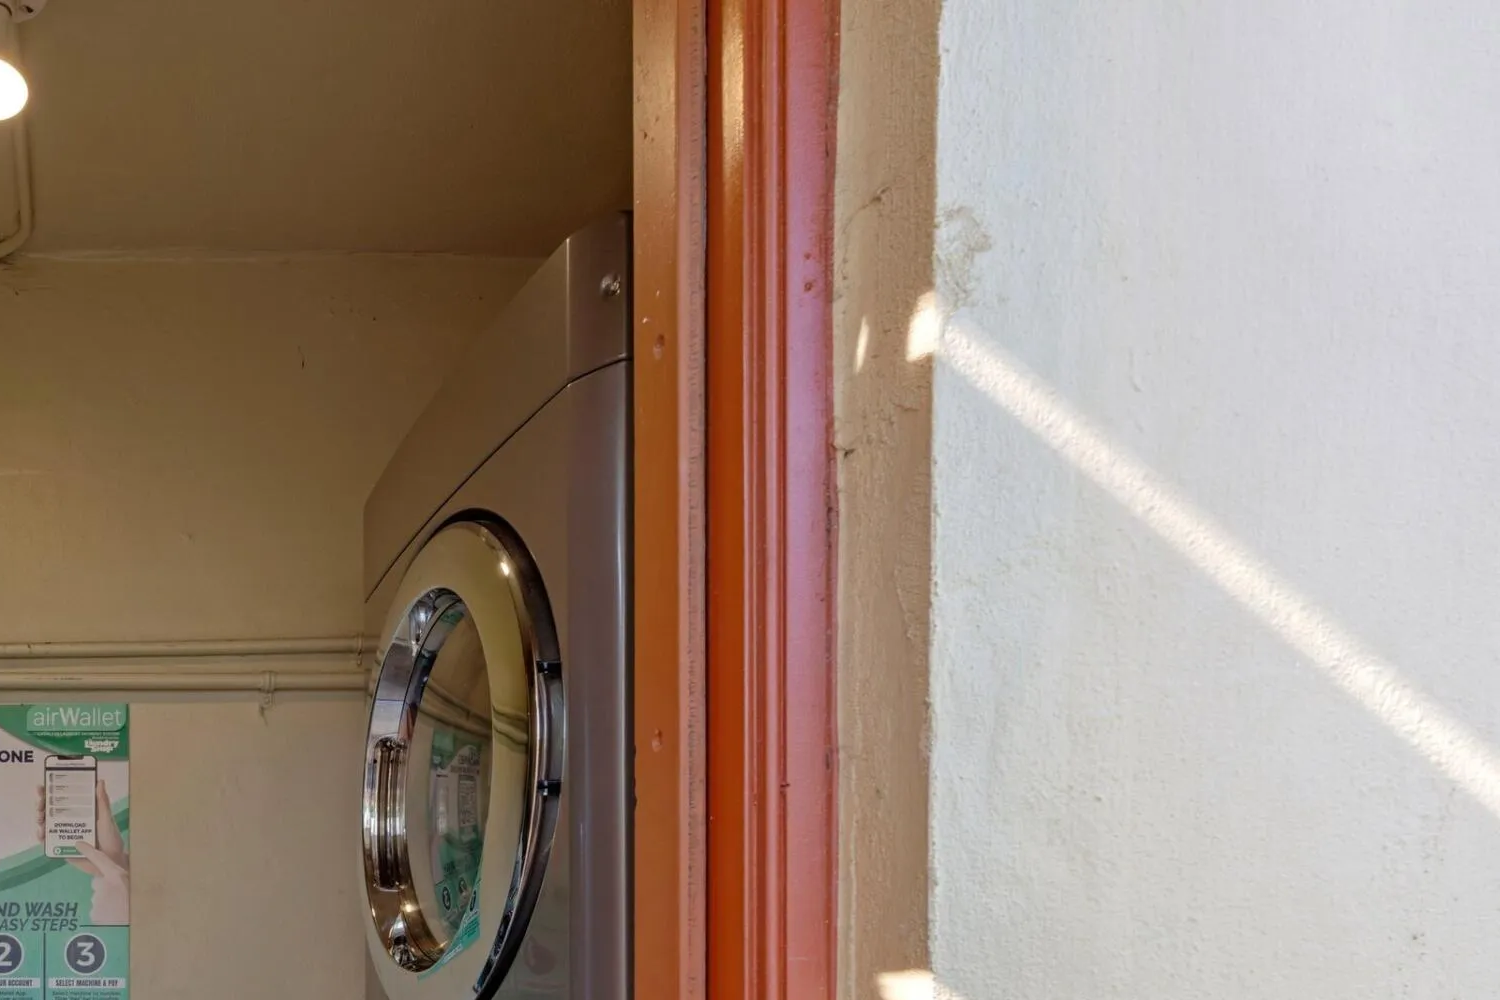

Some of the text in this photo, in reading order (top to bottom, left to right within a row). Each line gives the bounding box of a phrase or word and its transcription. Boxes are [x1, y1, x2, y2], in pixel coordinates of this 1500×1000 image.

[33, 706, 122, 727] airWallet
[25, 902, 79, 918] WASH
[29, 918, 78, 932] STEPS
[75, 941, 95, 967] 3
[8, 979, 33, 987] ACCOUNT
[55, 979, 75, 987] SELECT
